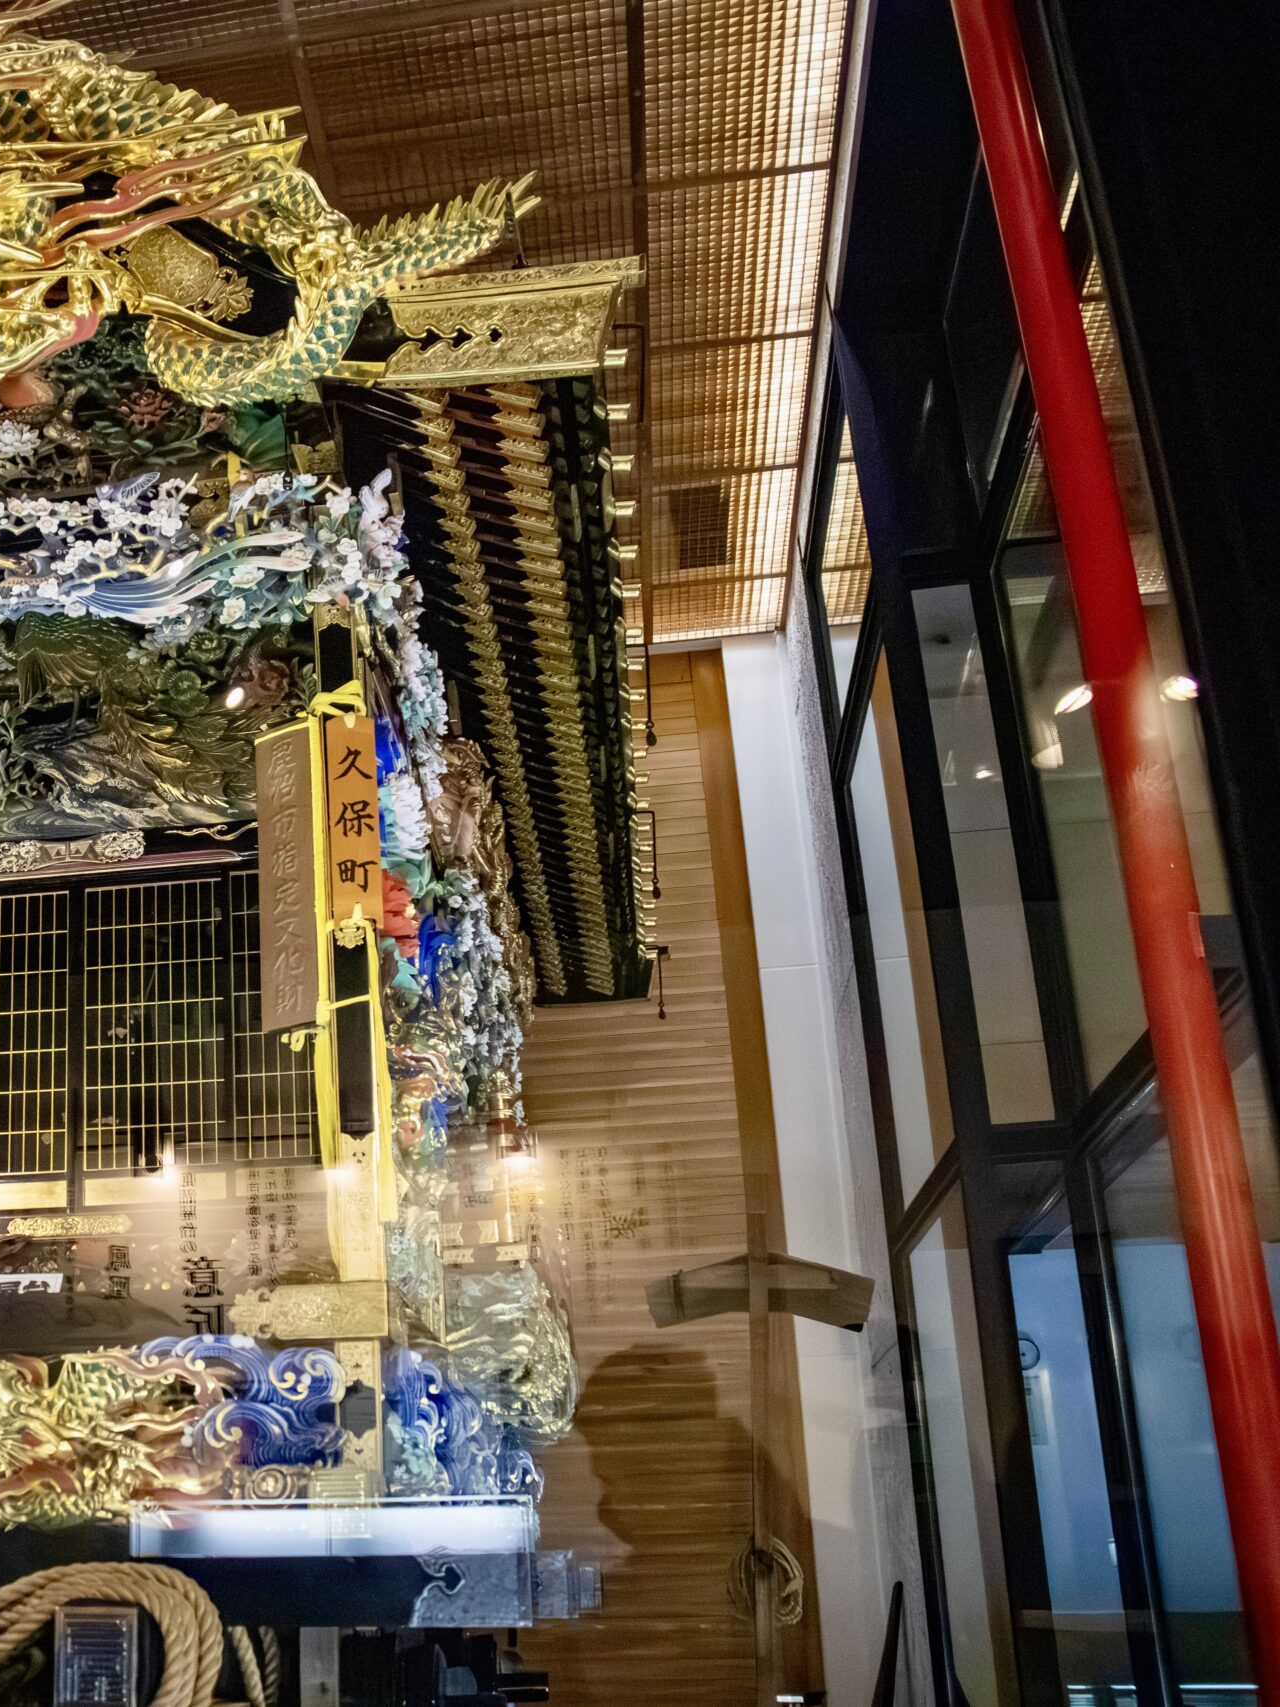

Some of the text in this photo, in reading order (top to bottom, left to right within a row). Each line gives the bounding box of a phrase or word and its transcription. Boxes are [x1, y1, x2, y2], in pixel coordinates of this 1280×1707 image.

[267, 737, 304, 1014] 鹿沼市指定文化財
[334, 745, 378, 893] 久保町
